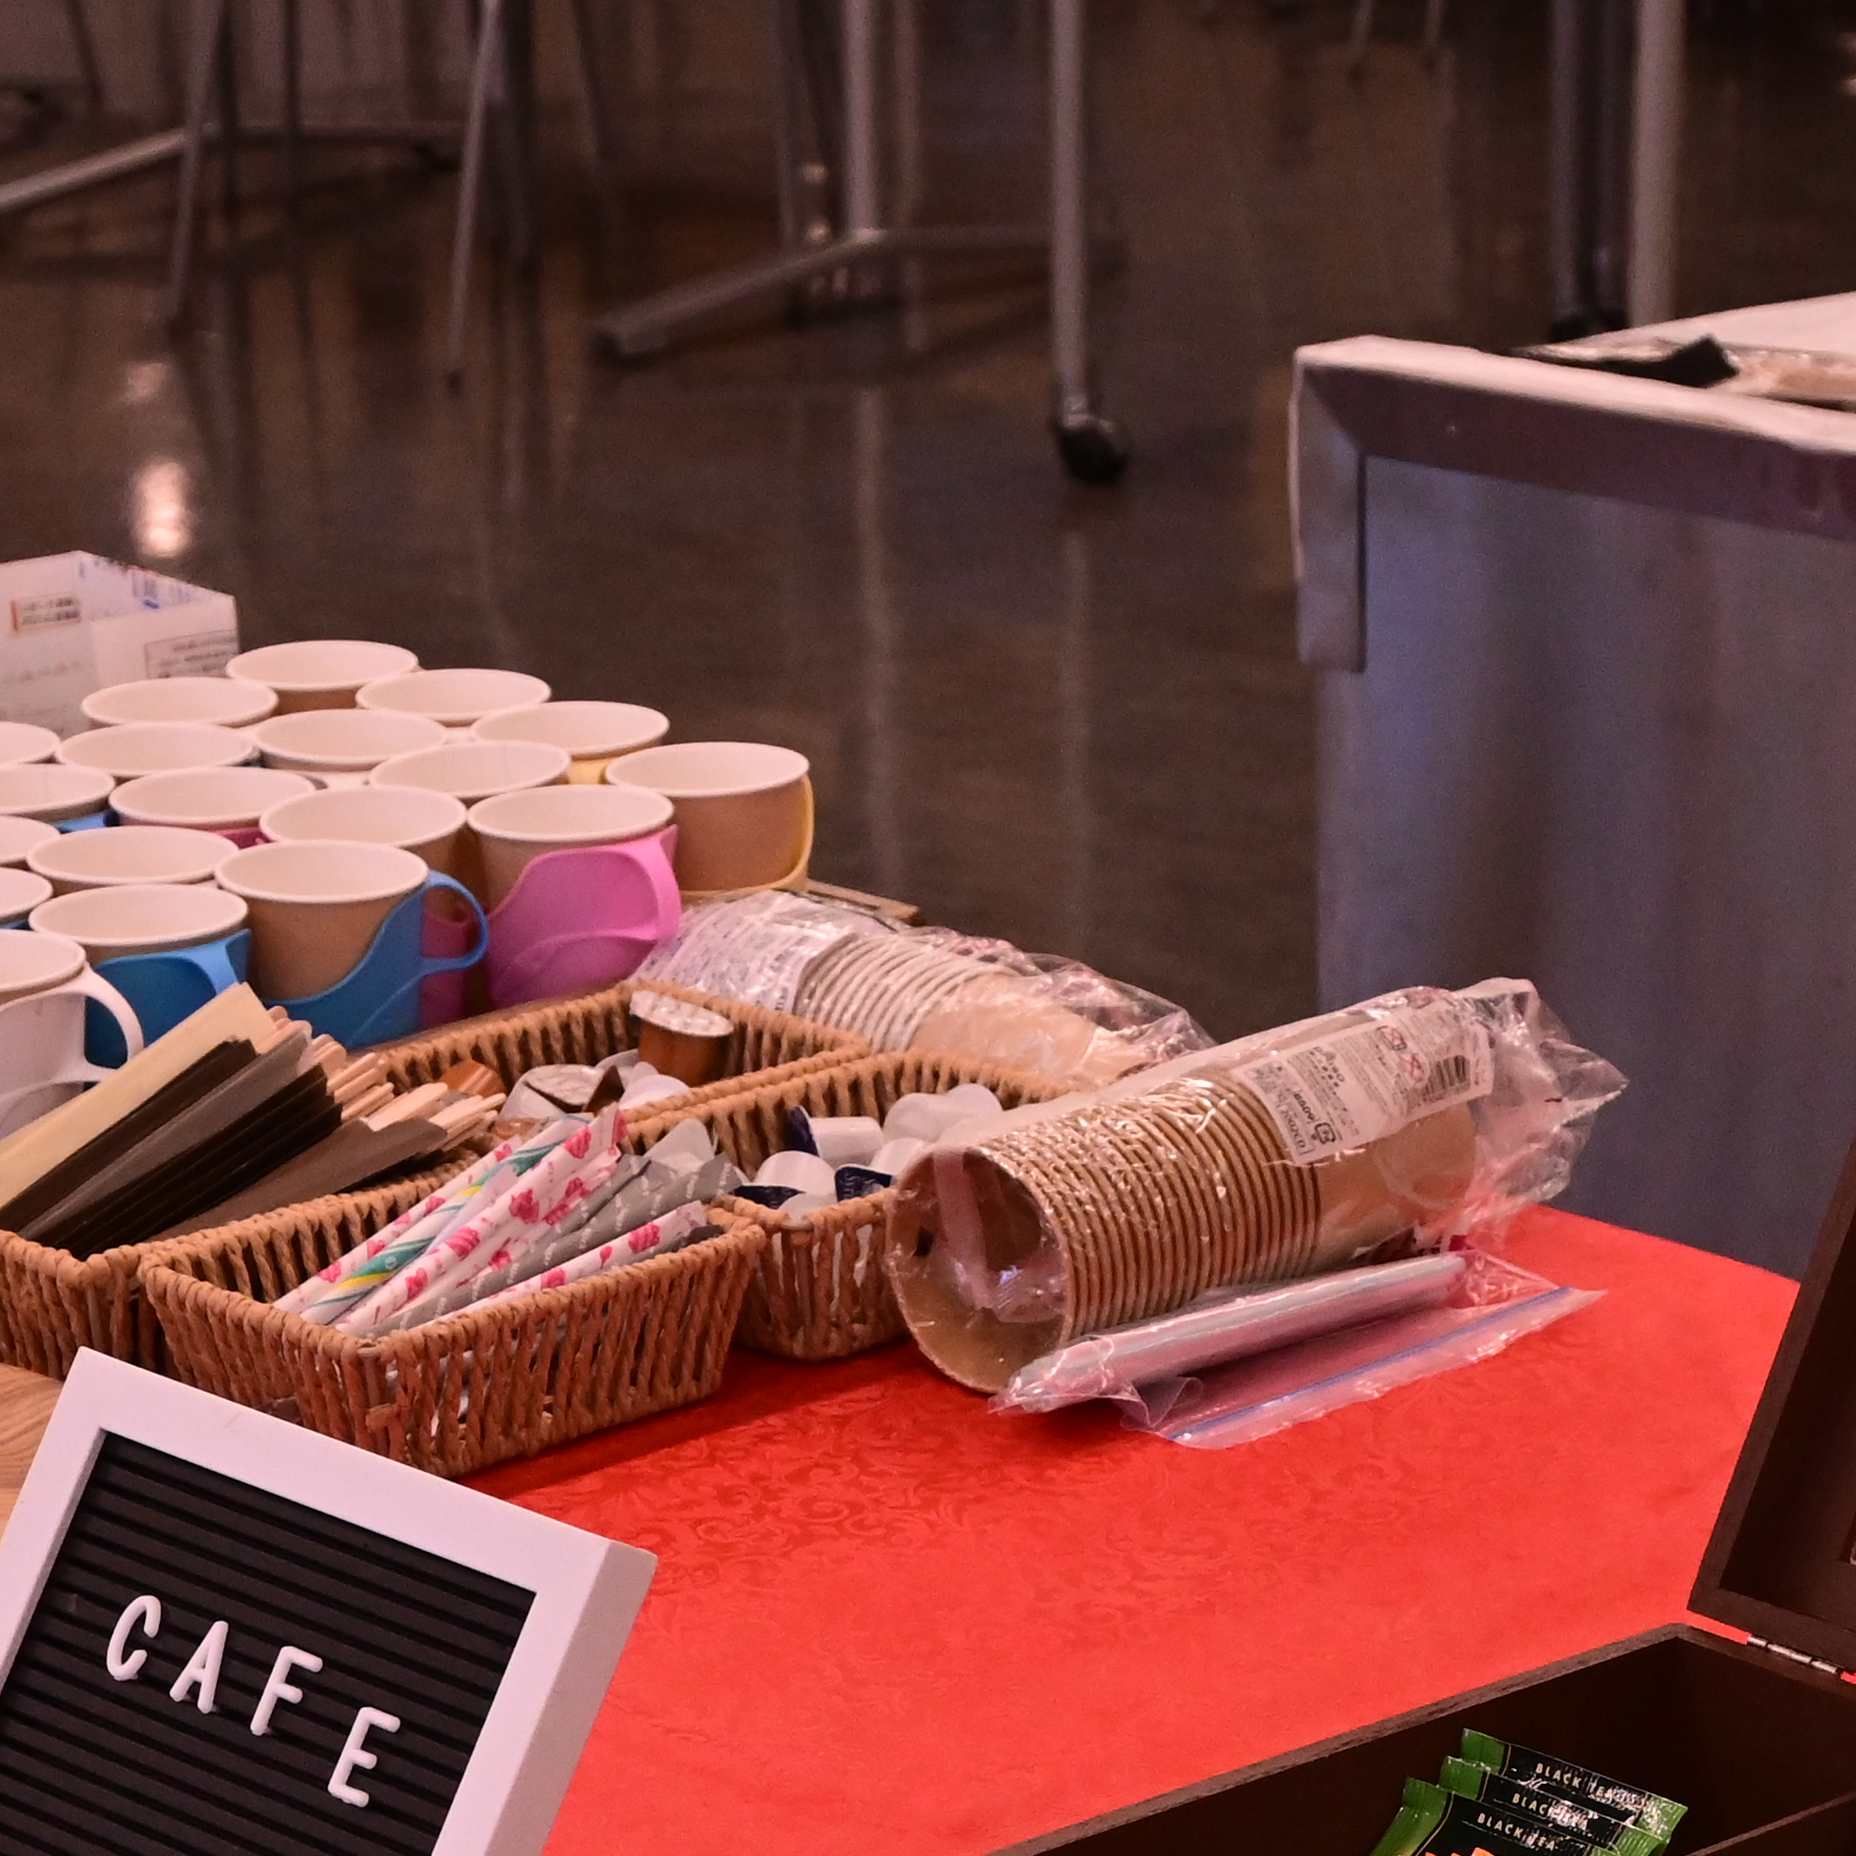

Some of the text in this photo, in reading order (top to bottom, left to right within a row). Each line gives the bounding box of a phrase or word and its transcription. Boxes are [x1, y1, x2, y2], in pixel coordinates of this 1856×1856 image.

[105, 1594, 401, 1808] CAFE
[1535, 1762, 1583, 1789] BLACK
[1477, 1812, 1524, 1838] BLACK
